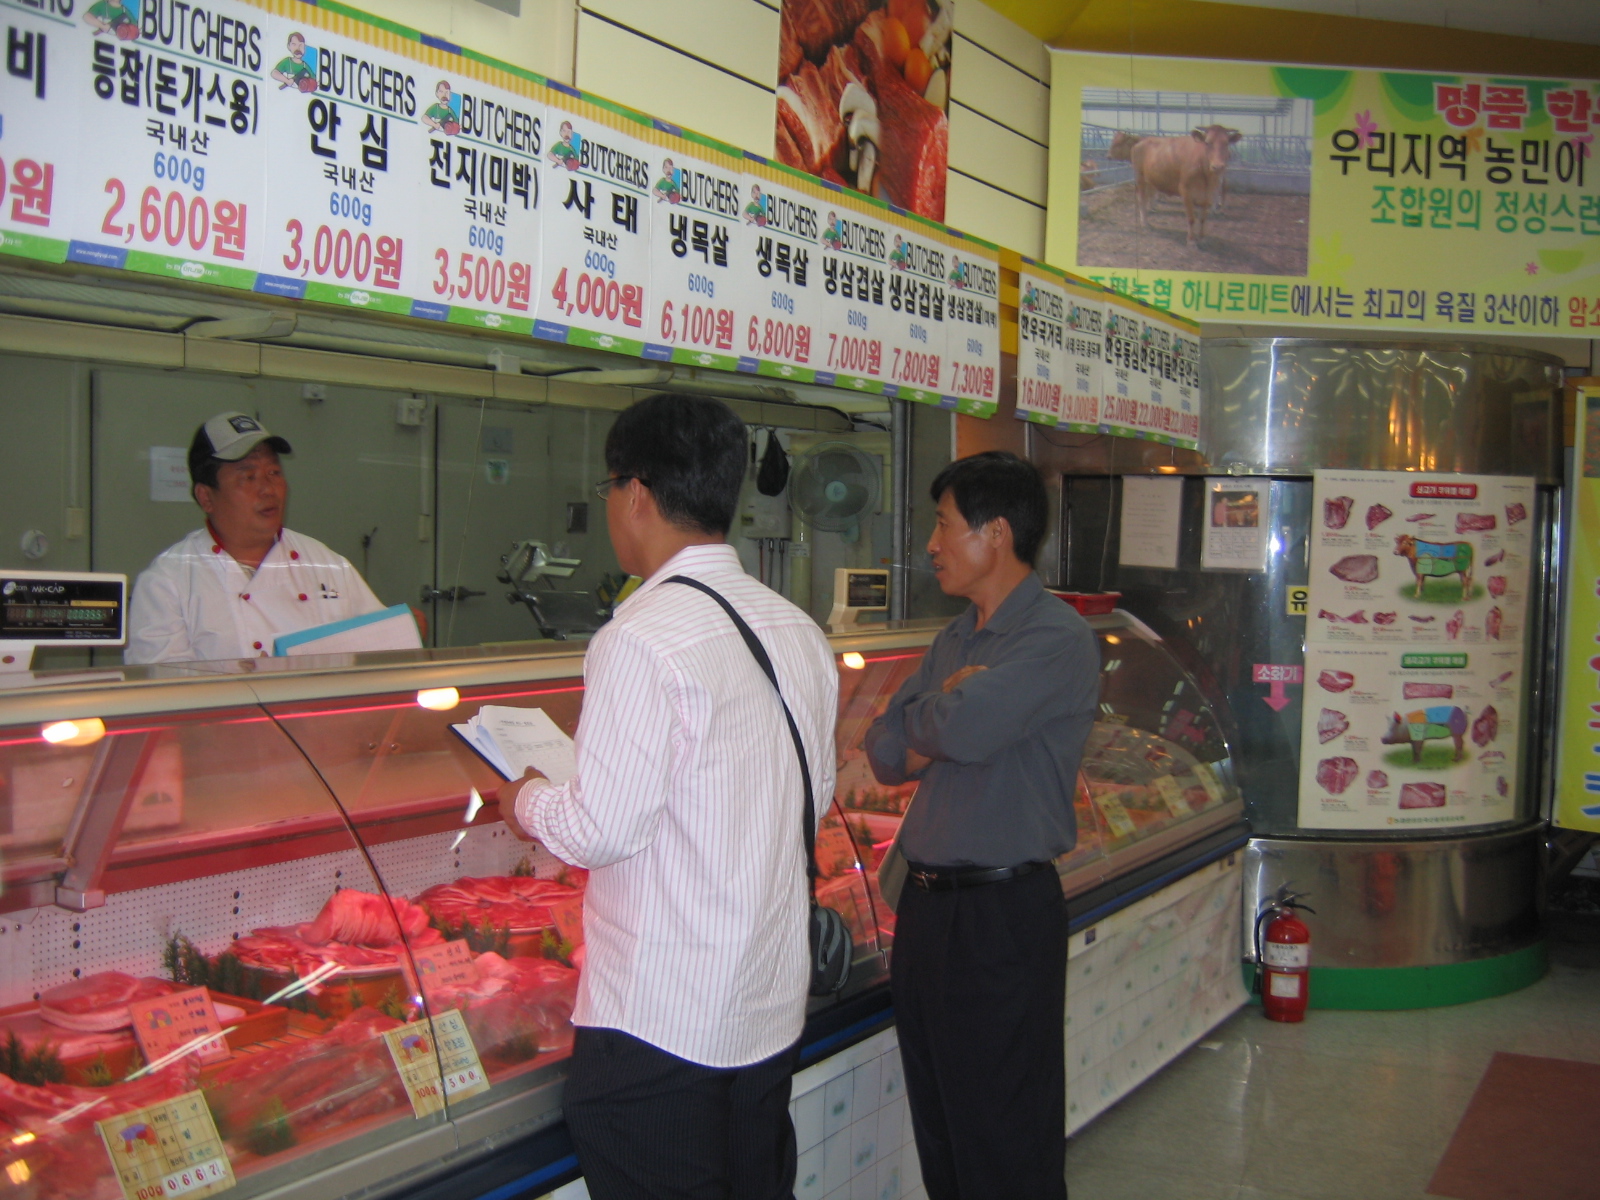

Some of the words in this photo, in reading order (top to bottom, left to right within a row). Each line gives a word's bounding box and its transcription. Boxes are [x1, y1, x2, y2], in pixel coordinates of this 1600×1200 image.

[141, 0, 262, 72] BUTCHERS
[92, 40, 259, 135] 등잡(돈가스용)
[319, 47, 417, 117] BUTCHERS
[461, 93, 542, 156] BUTCHERS
[1436, 83, 1529, 131] 명품
[146, 118, 210, 156] 국내산
[1329, 129, 1467, 182] 우리지역
[1484, 137, 1584, 187] 농민이
[153, 151, 205, 191] 600g
[323, 162, 375, 194] 국내산
[429, 138, 539, 210] 전지(미박)
[581, 138, 649, 189] BUTCHERS
[329, 191, 372, 226] 600g
[463, 198, 507, 226] 국내산
[681, 168, 739, 217] BUTCHERS
[766, 193, 818, 239] BUTCHERS
[1370, 185, 1481, 231] 조합원의
[1494, 190, 1600, 236] 정성스런
[101, 177, 247, 262] 2,600원
[468, 224, 504, 256] 600g
[583, 226, 618, 251] 국내산
[669, 212, 729, 268] 냉목살
[841, 219, 886, 259] BUTCHERS
[283, 218, 403, 290] 3,000원
[584, 249, 615, 279] 600g
[755, 236, 809, 287] 생목살
[906, 241, 945, 279] BUTCHERS
[963, 261, 996, 295] BUTCHERS
[433, 247, 532, 312] 3,500원
[551, 267, 643, 328] 4,000원
[688, 273, 714, 298] 600g
[771, 290, 794, 315] 600g
[822, 256, 885, 305] 냉삼겹살
[889, 274, 945, 322] 생삼겹살
[1182, 279, 1354, 319] 하나로마트에서는
[1362, 288, 1426, 321] 최고의
[1435, 291, 1476, 324] 육질
[1484, 294, 1559, 327] 3산이하
[660, 300, 734, 350] 6,100원
[747, 315, 811, 363] 6,800원
[847, 309, 867, 331] 600g
[909, 323, 927, 344] 600g
[827, 333, 882, 375] 7,000원
[891, 347, 941, 388] 7,800원
[951, 361, 995, 398] 7,300원
[1257, 665, 1298, 681] 소화기
